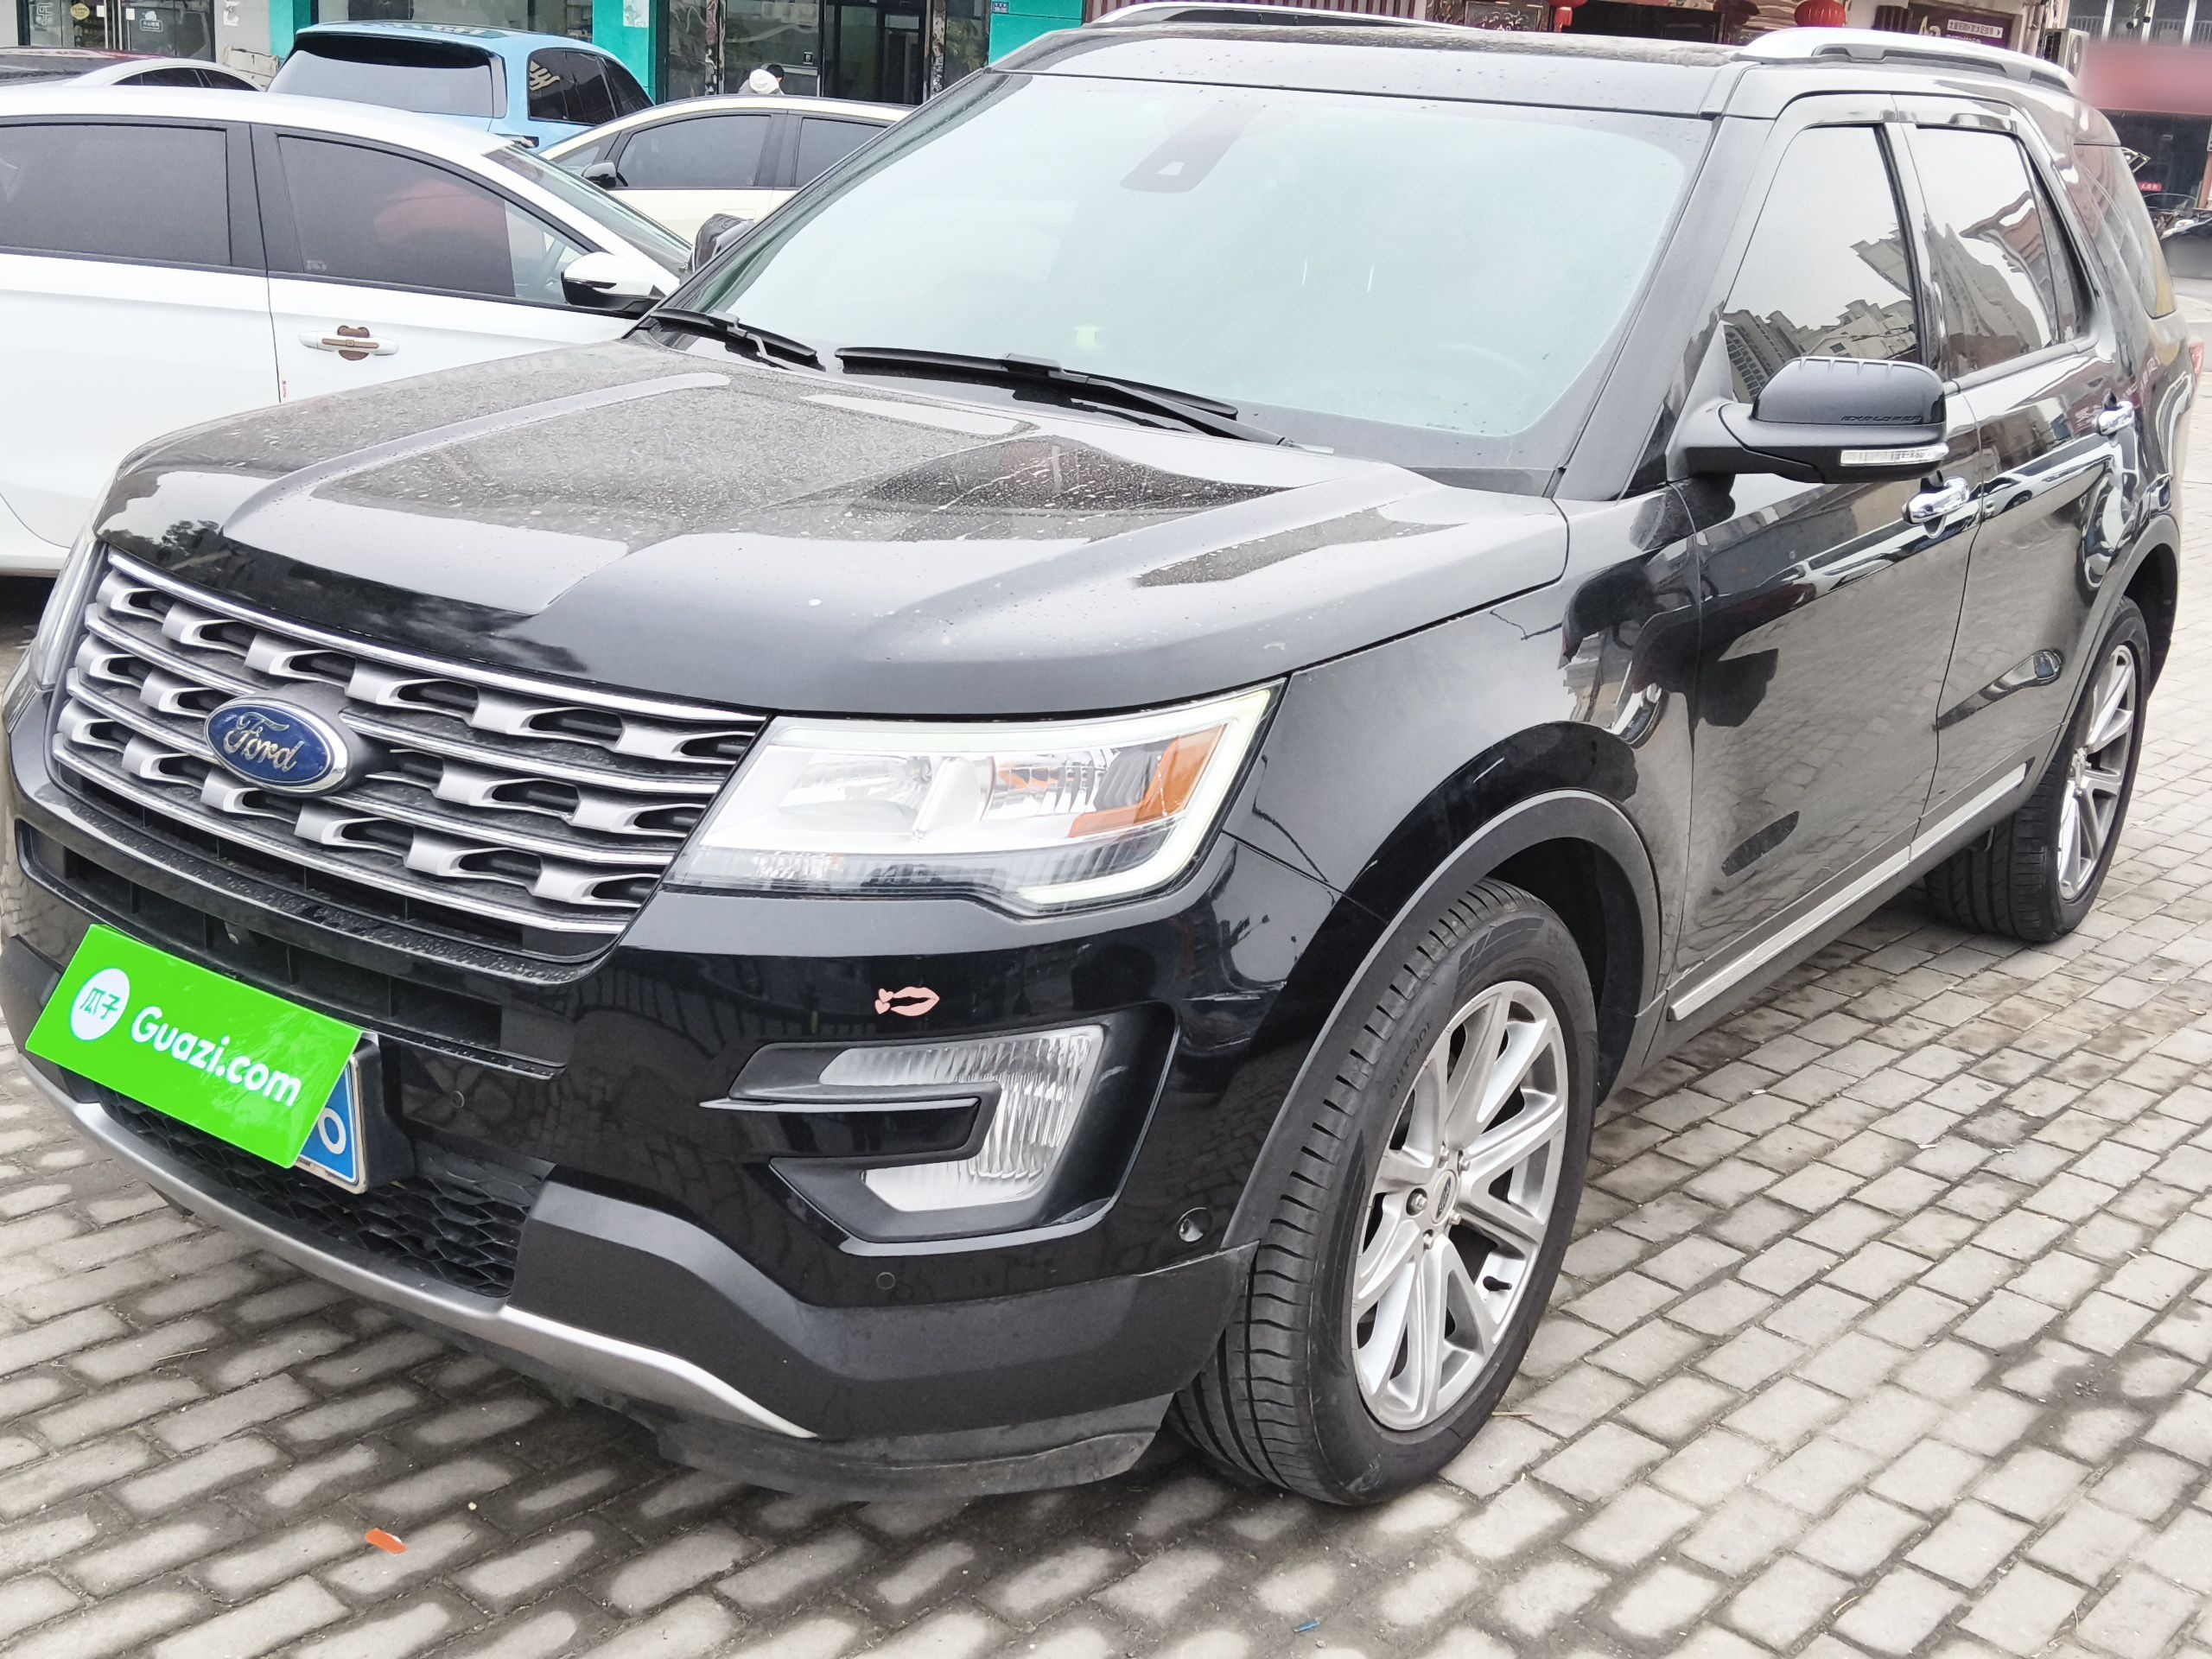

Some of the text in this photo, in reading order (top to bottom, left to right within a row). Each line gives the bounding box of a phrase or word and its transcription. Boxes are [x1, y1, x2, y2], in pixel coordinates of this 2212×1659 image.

[223, 711, 304, 772] Ford
[80, 988, 120, 1020] 瓜子
[131, 1006, 302, 1106] Guazi.com
